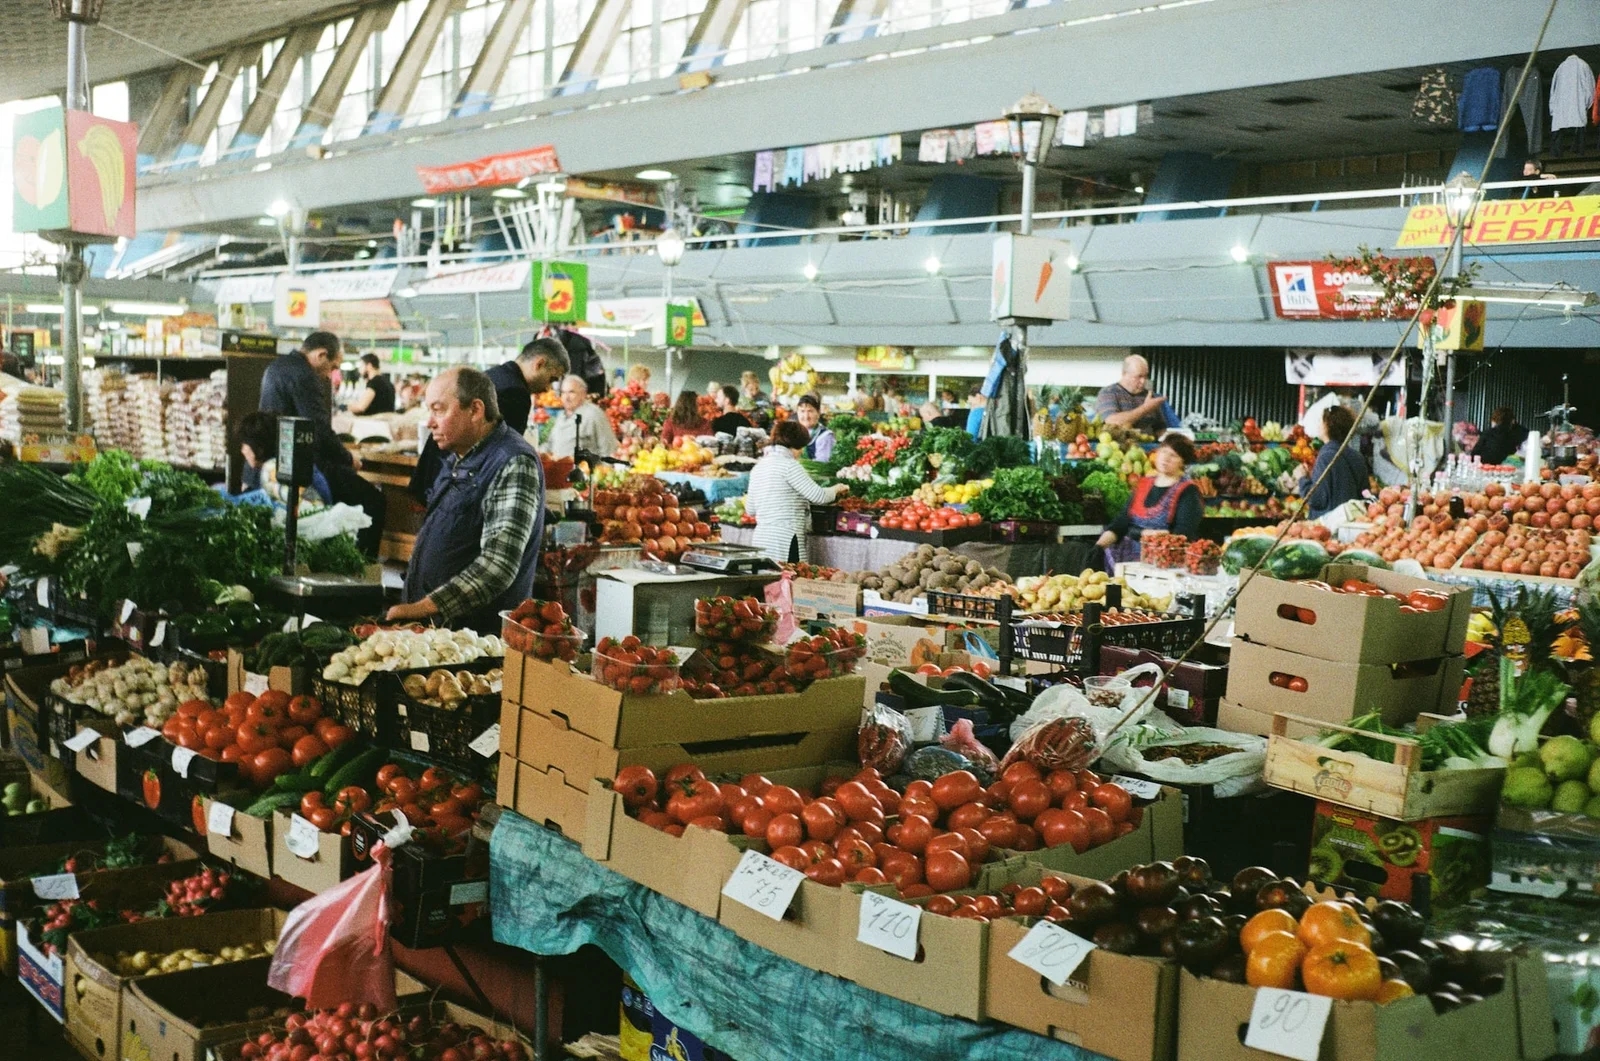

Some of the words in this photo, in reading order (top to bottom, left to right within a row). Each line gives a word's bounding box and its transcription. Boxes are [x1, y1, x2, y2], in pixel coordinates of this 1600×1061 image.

[1412, 199, 1575, 221] ФУНІТУРА
[749, 878, 785, 907] 75
[867, 908, 914, 939] 110
[1022, 932, 1080, 968] 90
[1259, 993, 1310, 1034] 90
